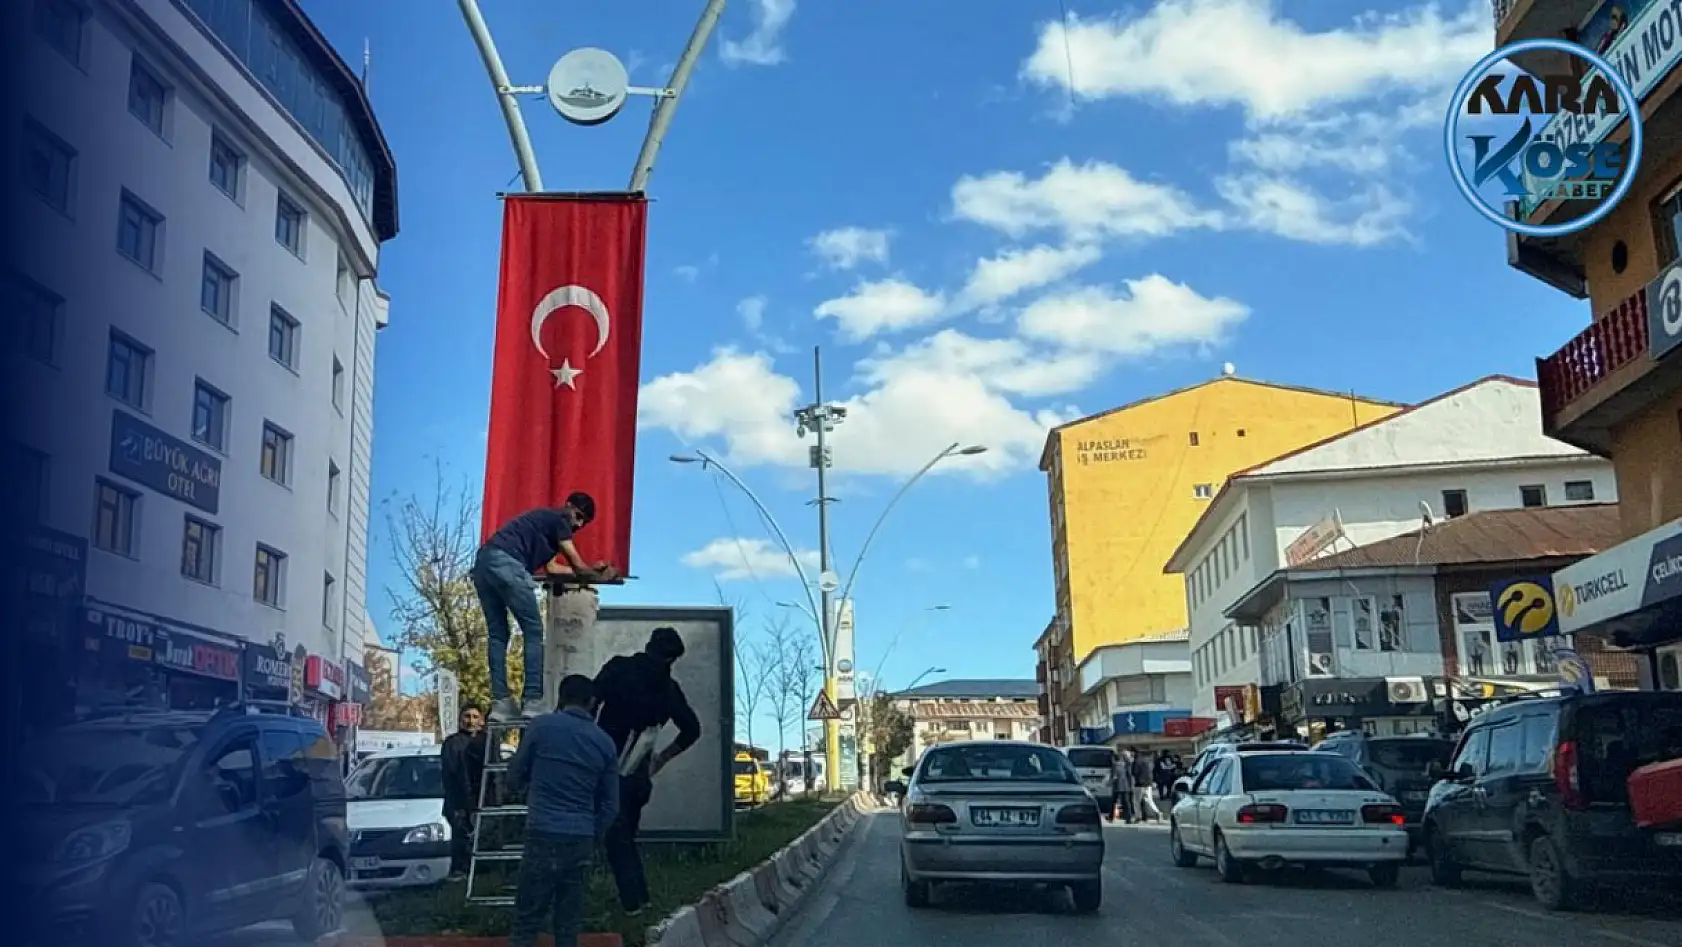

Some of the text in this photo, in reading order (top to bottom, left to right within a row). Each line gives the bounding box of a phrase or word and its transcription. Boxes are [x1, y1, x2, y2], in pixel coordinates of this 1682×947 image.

[144, 436, 189, 474] BÜYÜK
[1077, 438, 1130, 451] ALPASLAN
[168, 472, 196, 500] OTEL
[1575, 568, 1629, 605] TURKCELL
